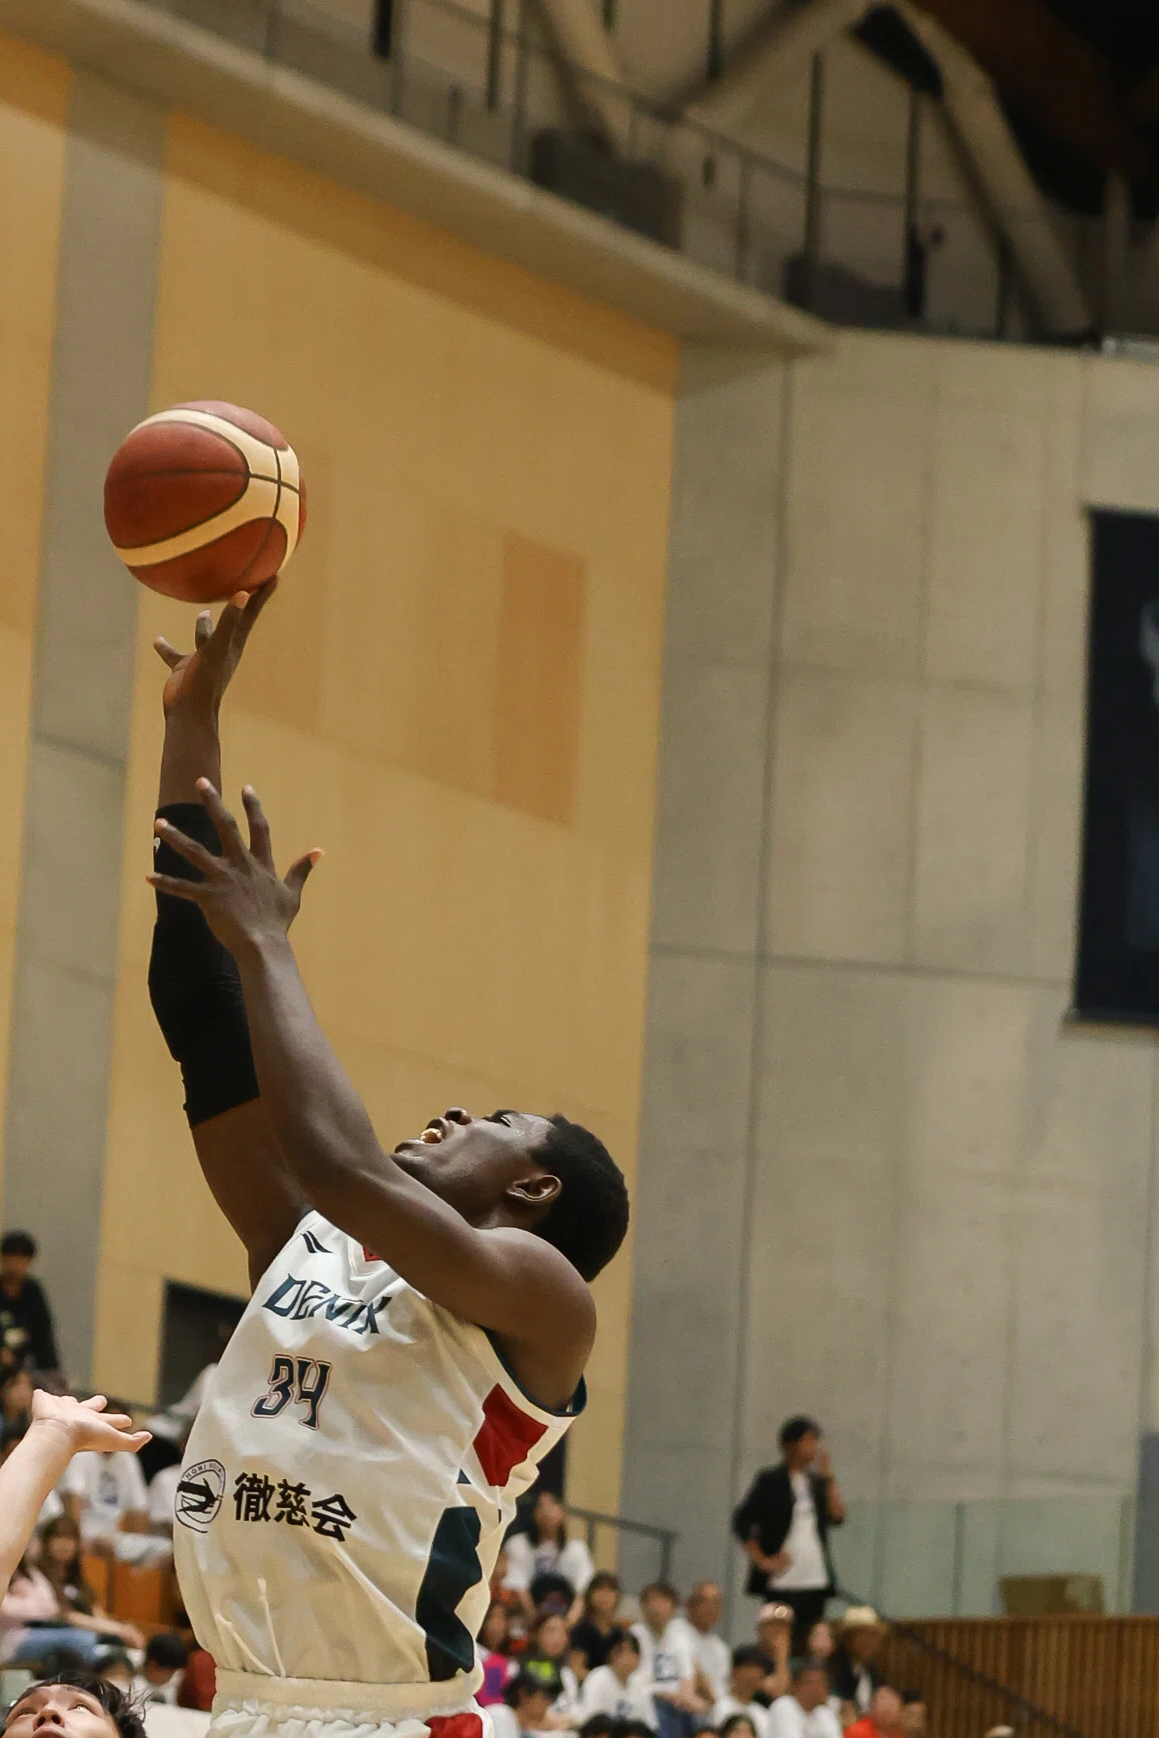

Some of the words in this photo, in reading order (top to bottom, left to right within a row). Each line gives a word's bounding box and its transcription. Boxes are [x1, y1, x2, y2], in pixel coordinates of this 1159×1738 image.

[261, 1273, 392, 1335] DENIX
[251, 1353, 333, 1431] 34
[232, 1470, 358, 1543] 徹慈会
